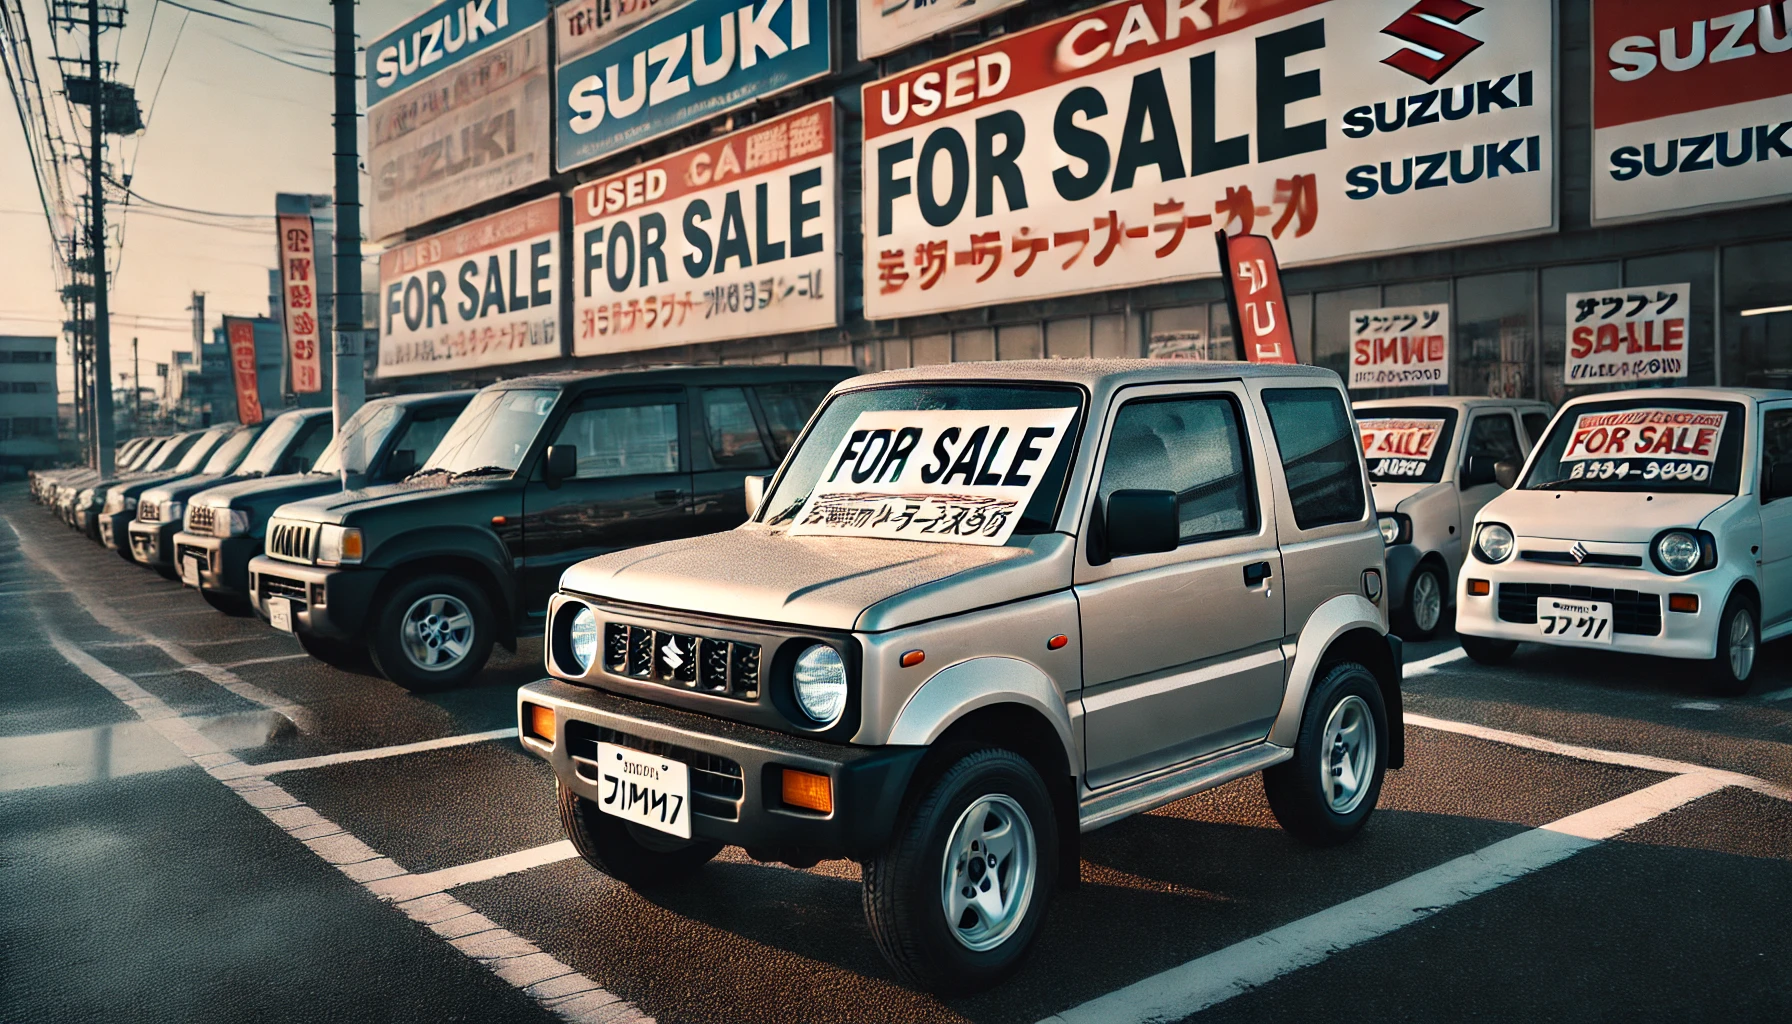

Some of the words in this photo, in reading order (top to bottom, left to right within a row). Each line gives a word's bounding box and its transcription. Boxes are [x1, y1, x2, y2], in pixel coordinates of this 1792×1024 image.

[376, 0, 508, 88] SUZUKI
[568, 0, 810, 134] SUZUKI
[881, 51, 1012, 126] USED
[1342, 70, 1533, 139] SUZUKI
[877, 109, 1029, 237] FOR
[1052, 17, 1327, 202] SALE
[587, 168, 668, 218] USED
[1345, 135, 1540, 200] SUZUKI
[584, 212, 669, 298] FOR
[682, 167, 824, 279] SALE
[386, 270, 448, 336] FOR
[458, 239, 552, 321] SALE
[827, 426, 924, 484] FOR
[920, 425, 1055, 487] SALE
[1565, 426, 1631, 457] FOR
[1635, 425, 1717, 456] SALE
